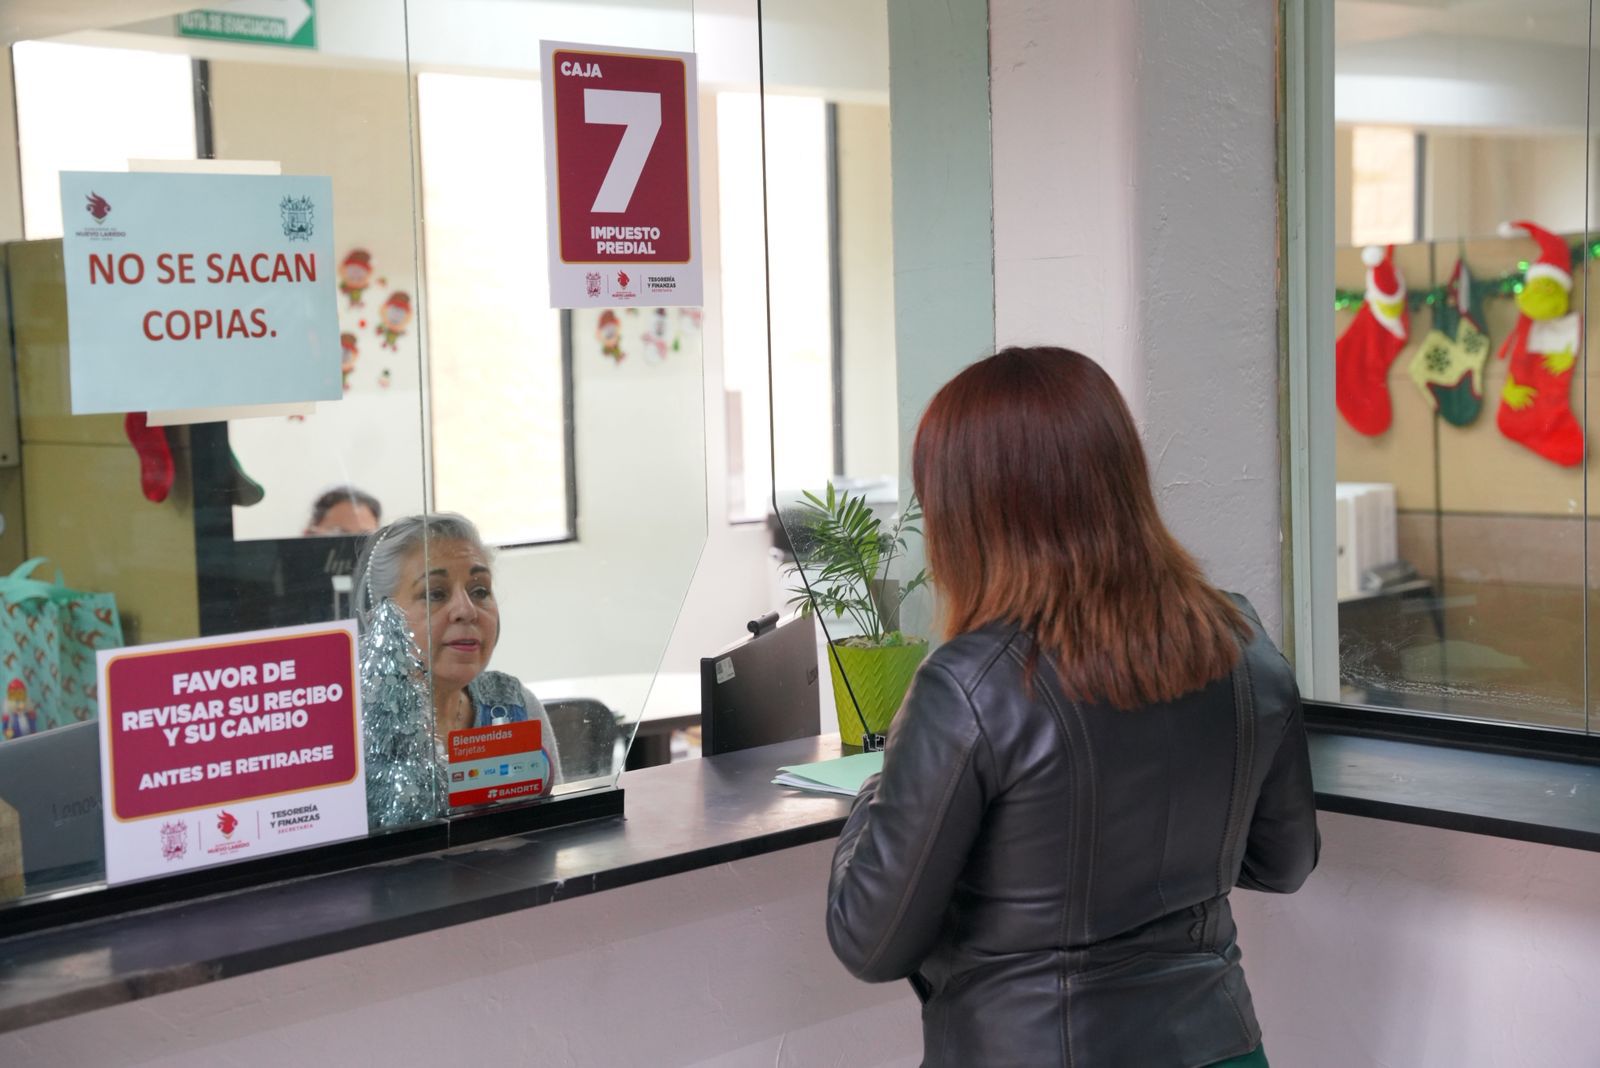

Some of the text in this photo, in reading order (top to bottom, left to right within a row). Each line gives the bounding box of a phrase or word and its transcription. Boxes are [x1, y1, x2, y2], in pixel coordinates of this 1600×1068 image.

[560, 61, 602, 78] CAJA
[584, 88, 662, 213] 7
[591, 226, 660, 240] IMPUESTO
[597, 241, 656, 255] PREDIAL
[89, 253, 316, 285] NO SE SACAN
[142, 308, 277, 341] COPIAS.
[173, 660, 296, 695] FAVOR DE
[122, 684, 343, 731] REVISAR SU RECIBO
[163, 709, 308, 746] Y SU CAMBIO
[453, 729, 512, 746] Bienvenidas
[454, 745, 486, 757] Tarjetas
[139, 745, 334, 790] ANTES DE RETIRARSE
[499, 784, 539, 796] BANORTE
[271, 804, 318, 819] TESORERÍA
[270, 813, 320, 829] Y FINANZAS
